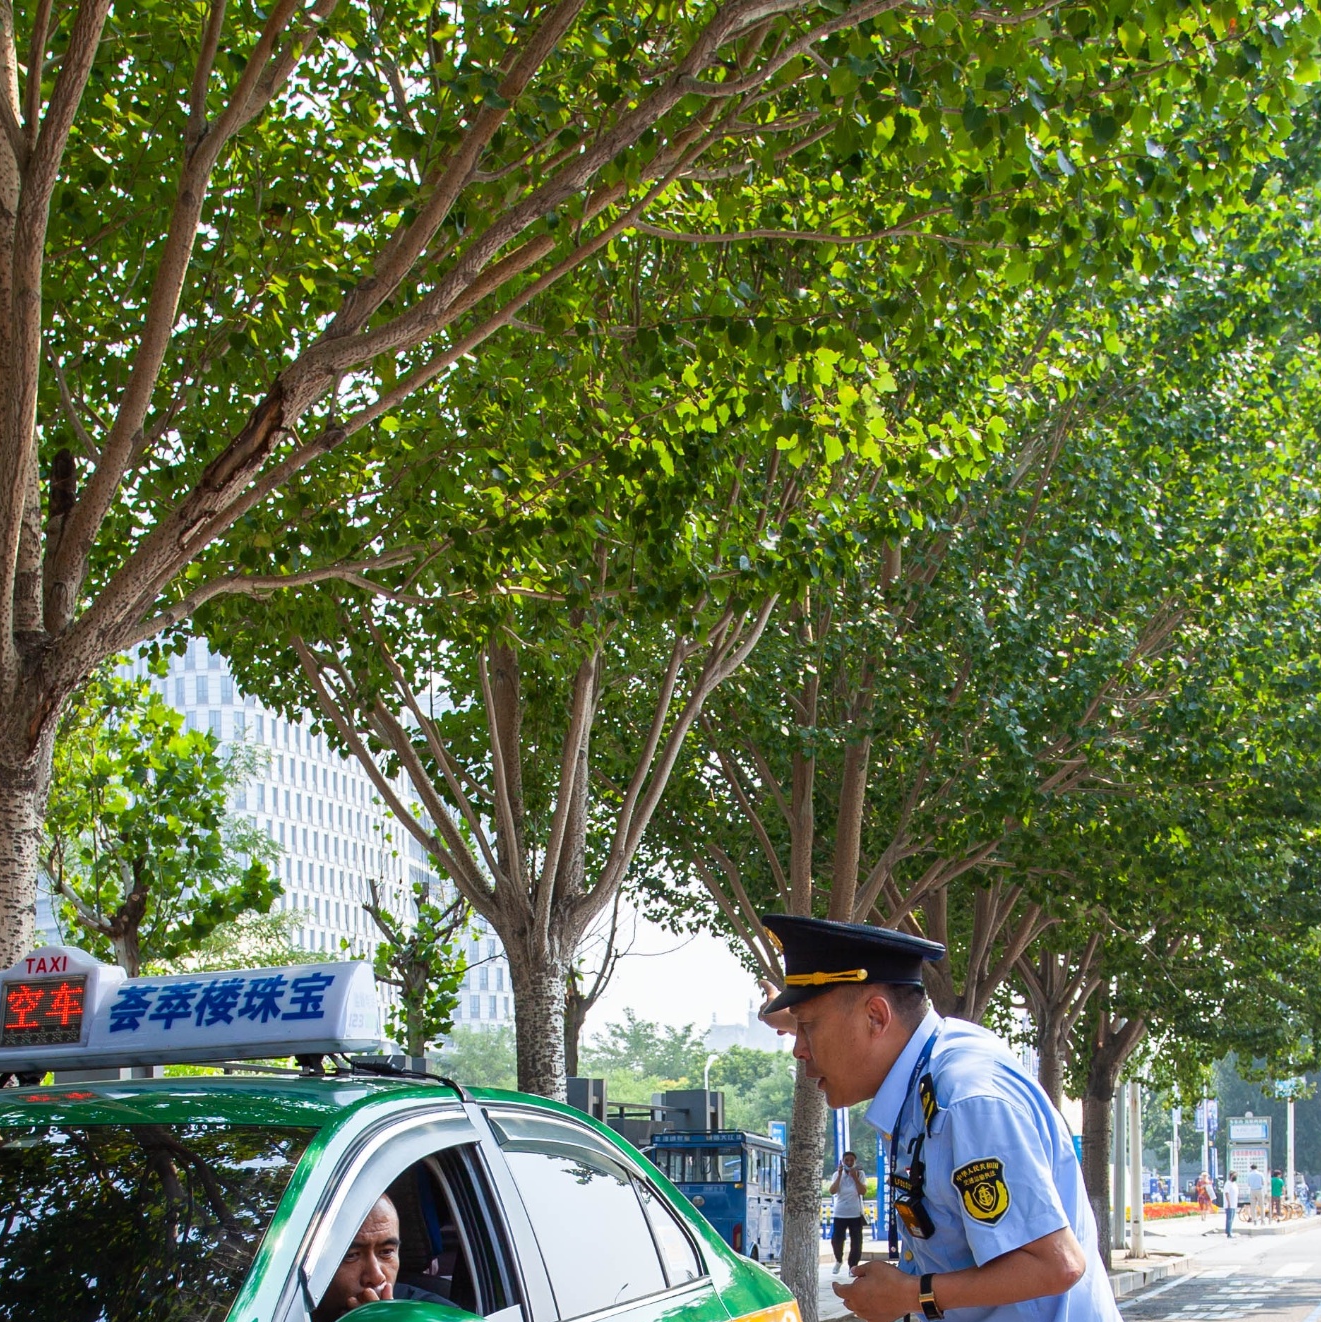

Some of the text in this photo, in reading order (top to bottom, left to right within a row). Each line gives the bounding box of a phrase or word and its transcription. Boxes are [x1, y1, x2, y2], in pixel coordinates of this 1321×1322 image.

[26, 956, 68, 974] TAXI
[5, 982, 83, 1029] 空车
[109, 971, 336, 1033] 荟萃楼珠宝
